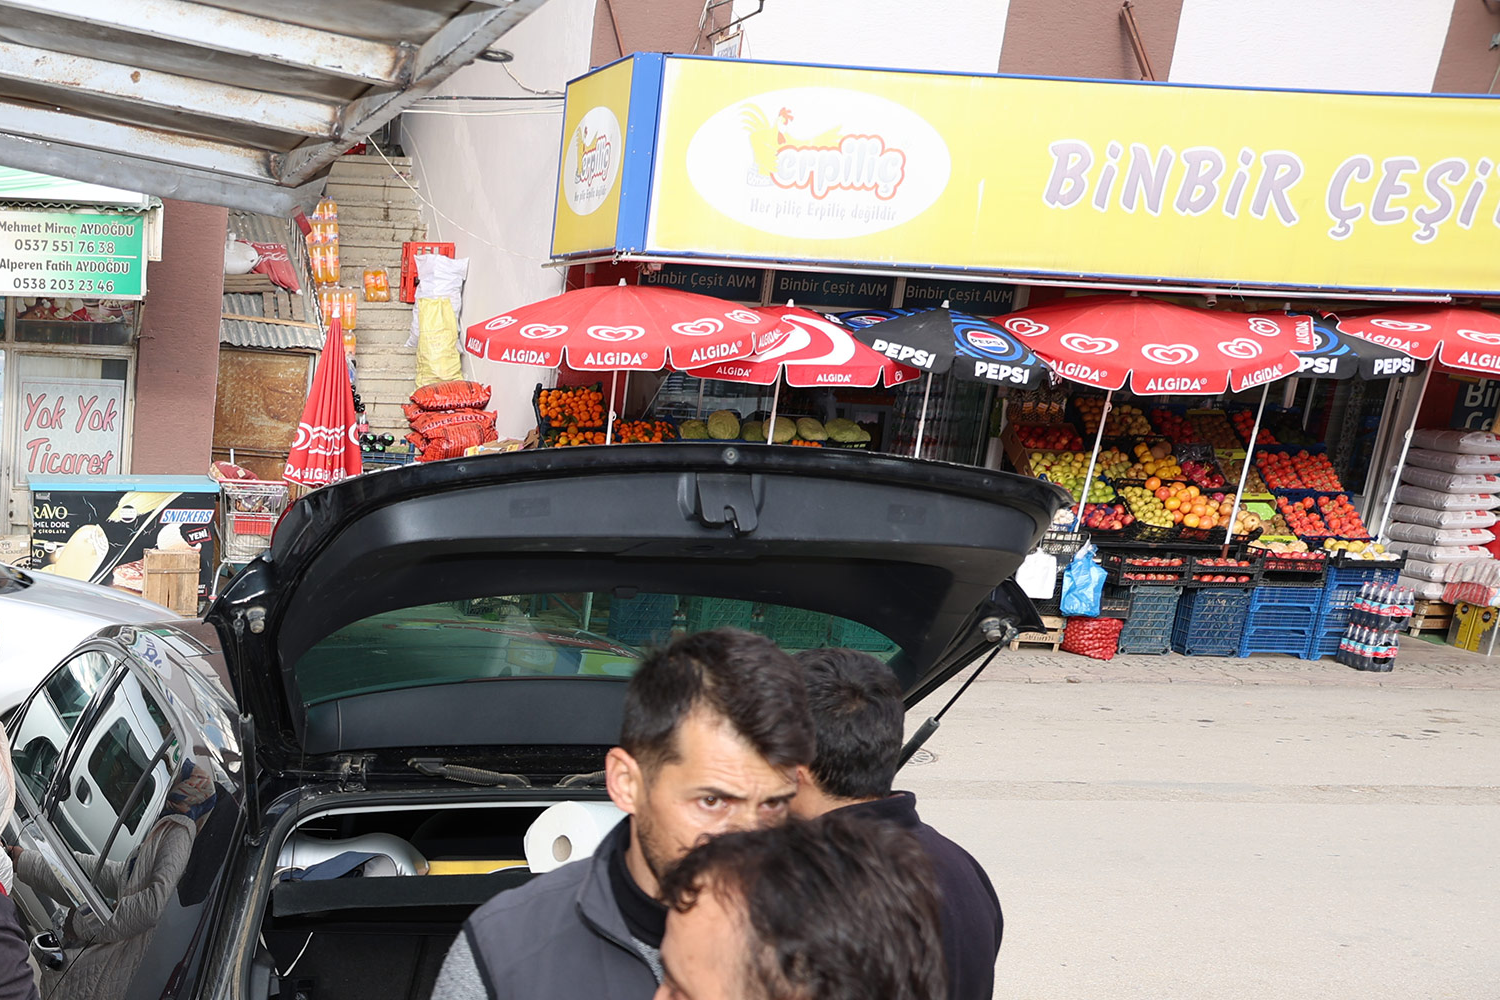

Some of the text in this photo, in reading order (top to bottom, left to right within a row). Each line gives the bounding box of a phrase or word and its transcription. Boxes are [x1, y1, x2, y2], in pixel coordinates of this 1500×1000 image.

[750, 198, 897, 223] Her piliç Erpiliç değildir
[45, 222, 77, 238] Miraç
[80, 221, 134, 236] AYDOĞDU
[14, 239, 114, 253] 0537 551 76 38
[0, 258, 129, 273] Alperen Fatih AYDOĞDU
[13, 278, 114, 292] 0538 203 23 46
[648, 272, 756, 289] Binbir Çeşit AVM
[780, 278, 887, 297] Binbir Çeşit AVM
[906, 286, 1013, 304] Binbir Çeşit AVM
[872, 339, 936, 368] PEPSI
[974, 361, 1030, 384] PEPSI
[1374, 358, 1414, 375] PEPSI
[24, 393, 117, 433] Yok Yok
[27, 438, 113, 474] Ticaret
[163, 510, 212, 522] SNICKERS
